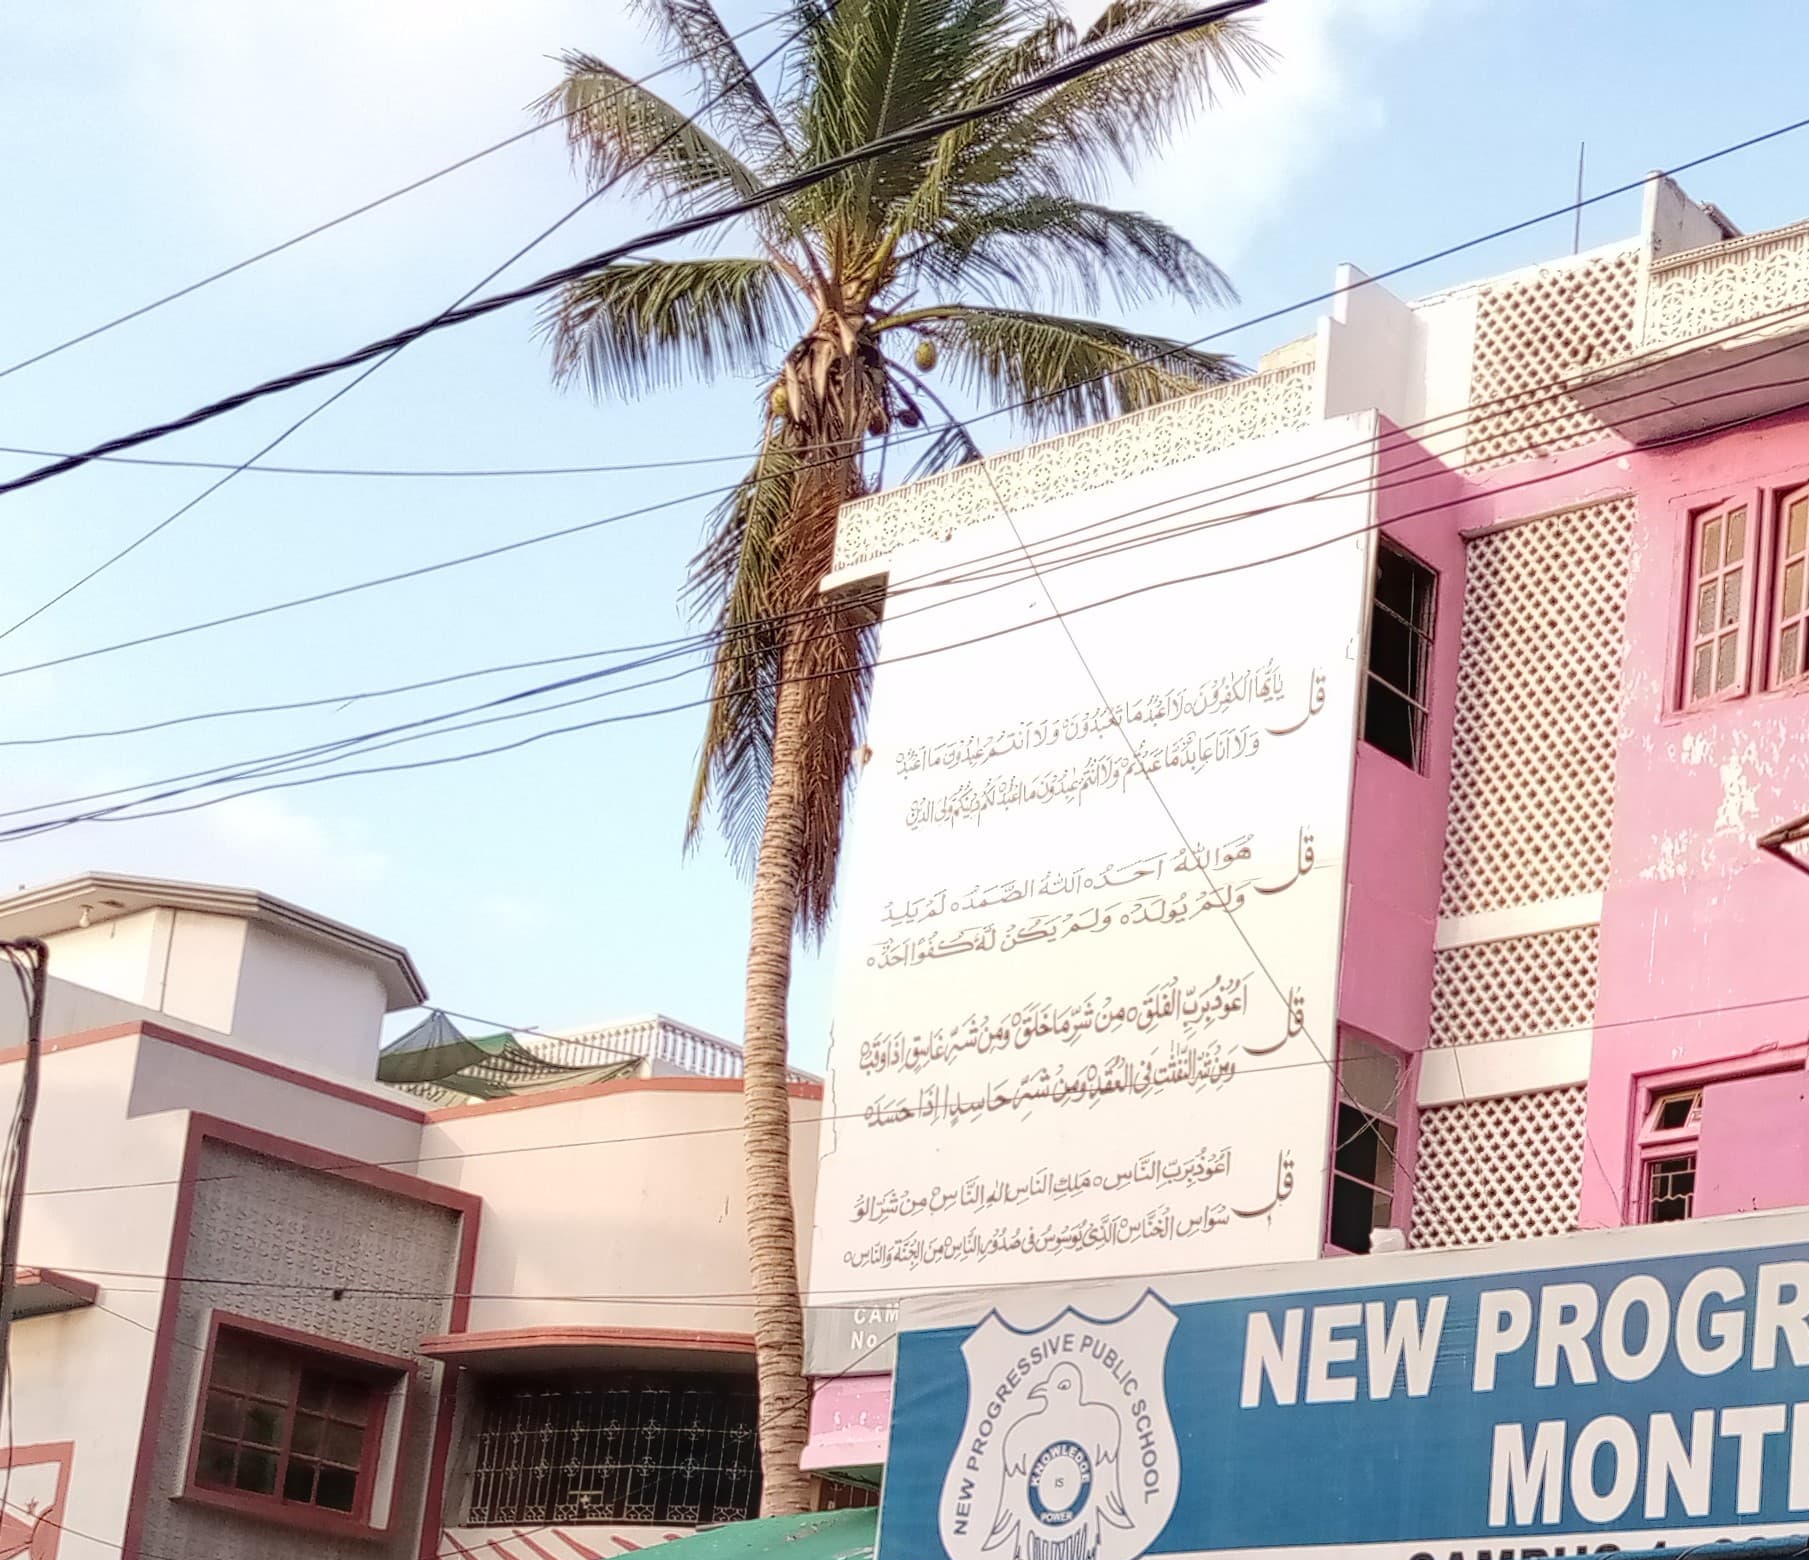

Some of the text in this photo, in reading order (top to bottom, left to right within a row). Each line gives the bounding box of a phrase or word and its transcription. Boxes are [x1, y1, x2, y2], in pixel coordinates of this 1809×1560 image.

[1239, 1294, 1449, 1408] NEW
[954, 1334, 1160, 1535] NEW PROGRESSIVE PUBLIC SCHOOL
